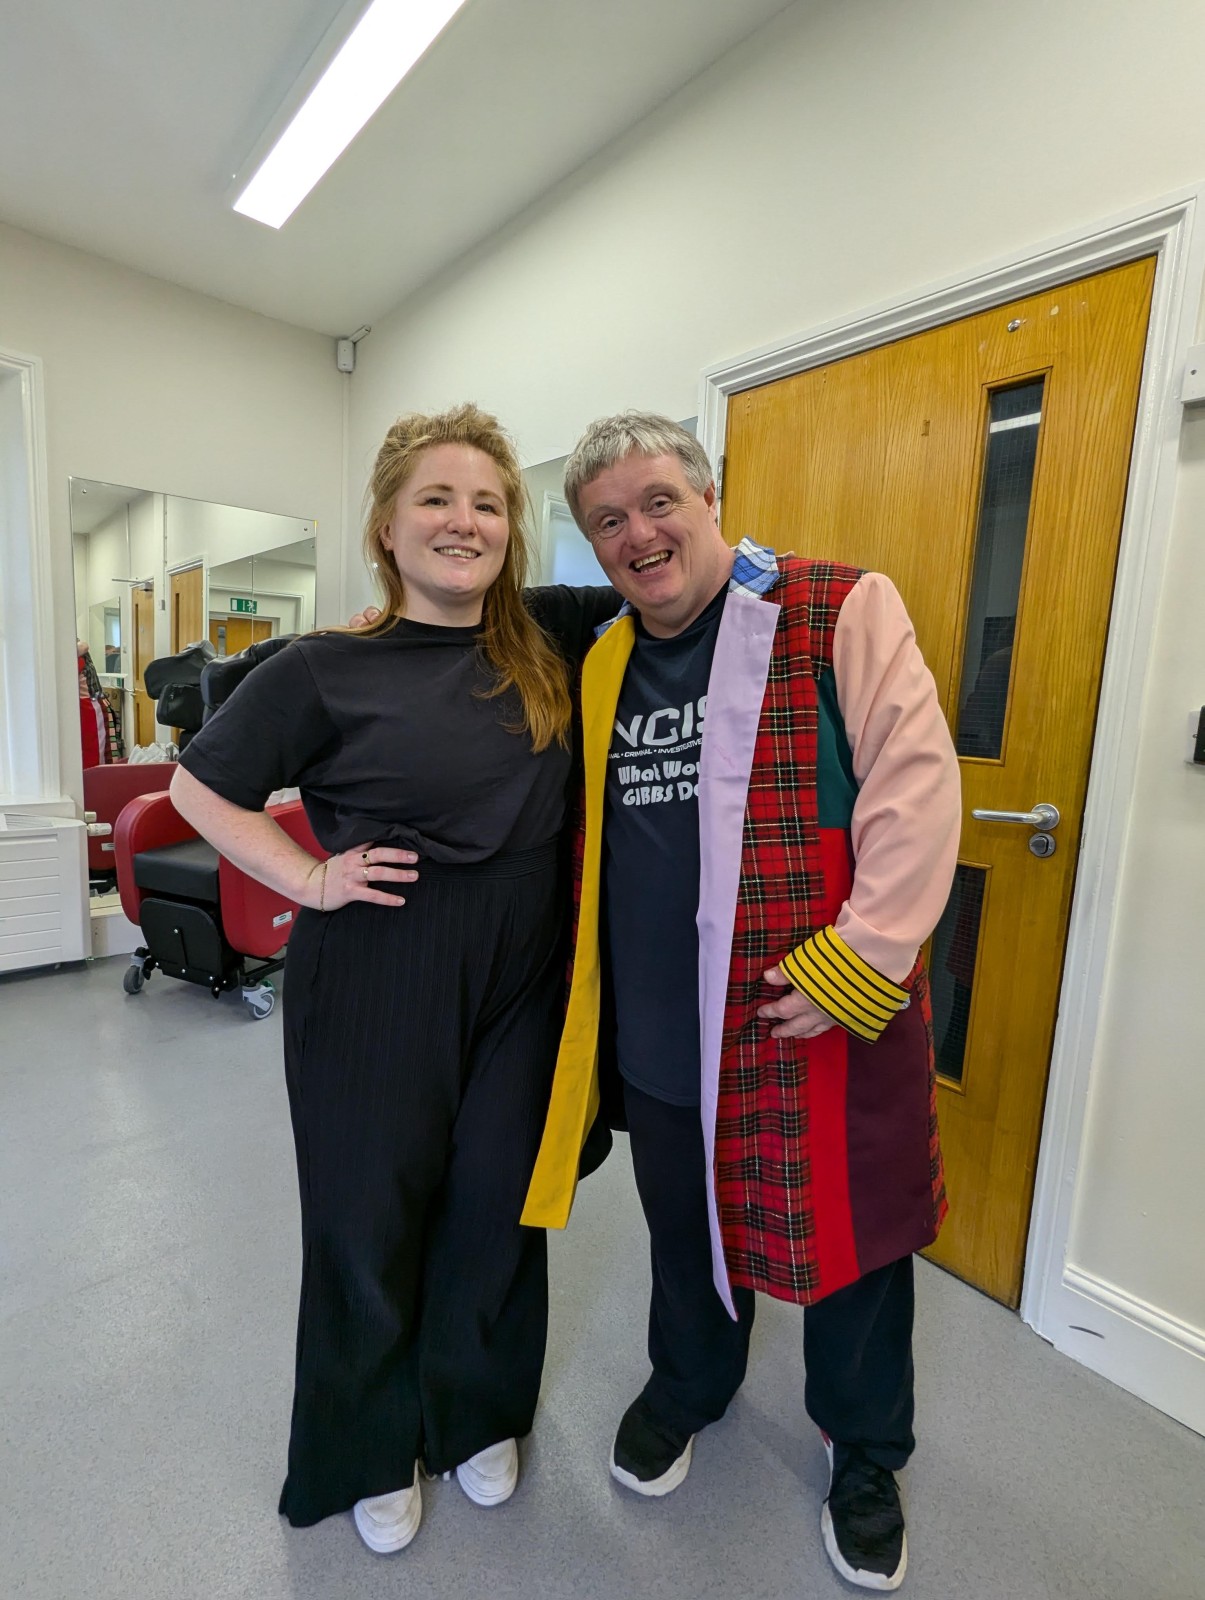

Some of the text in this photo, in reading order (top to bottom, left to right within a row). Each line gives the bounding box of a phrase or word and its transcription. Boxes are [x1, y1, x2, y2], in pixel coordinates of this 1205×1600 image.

[624, 749, 653, 758] CRIMINAL
[618, 763, 661, 785] What
[622, 784, 674, 806] GIBBS
